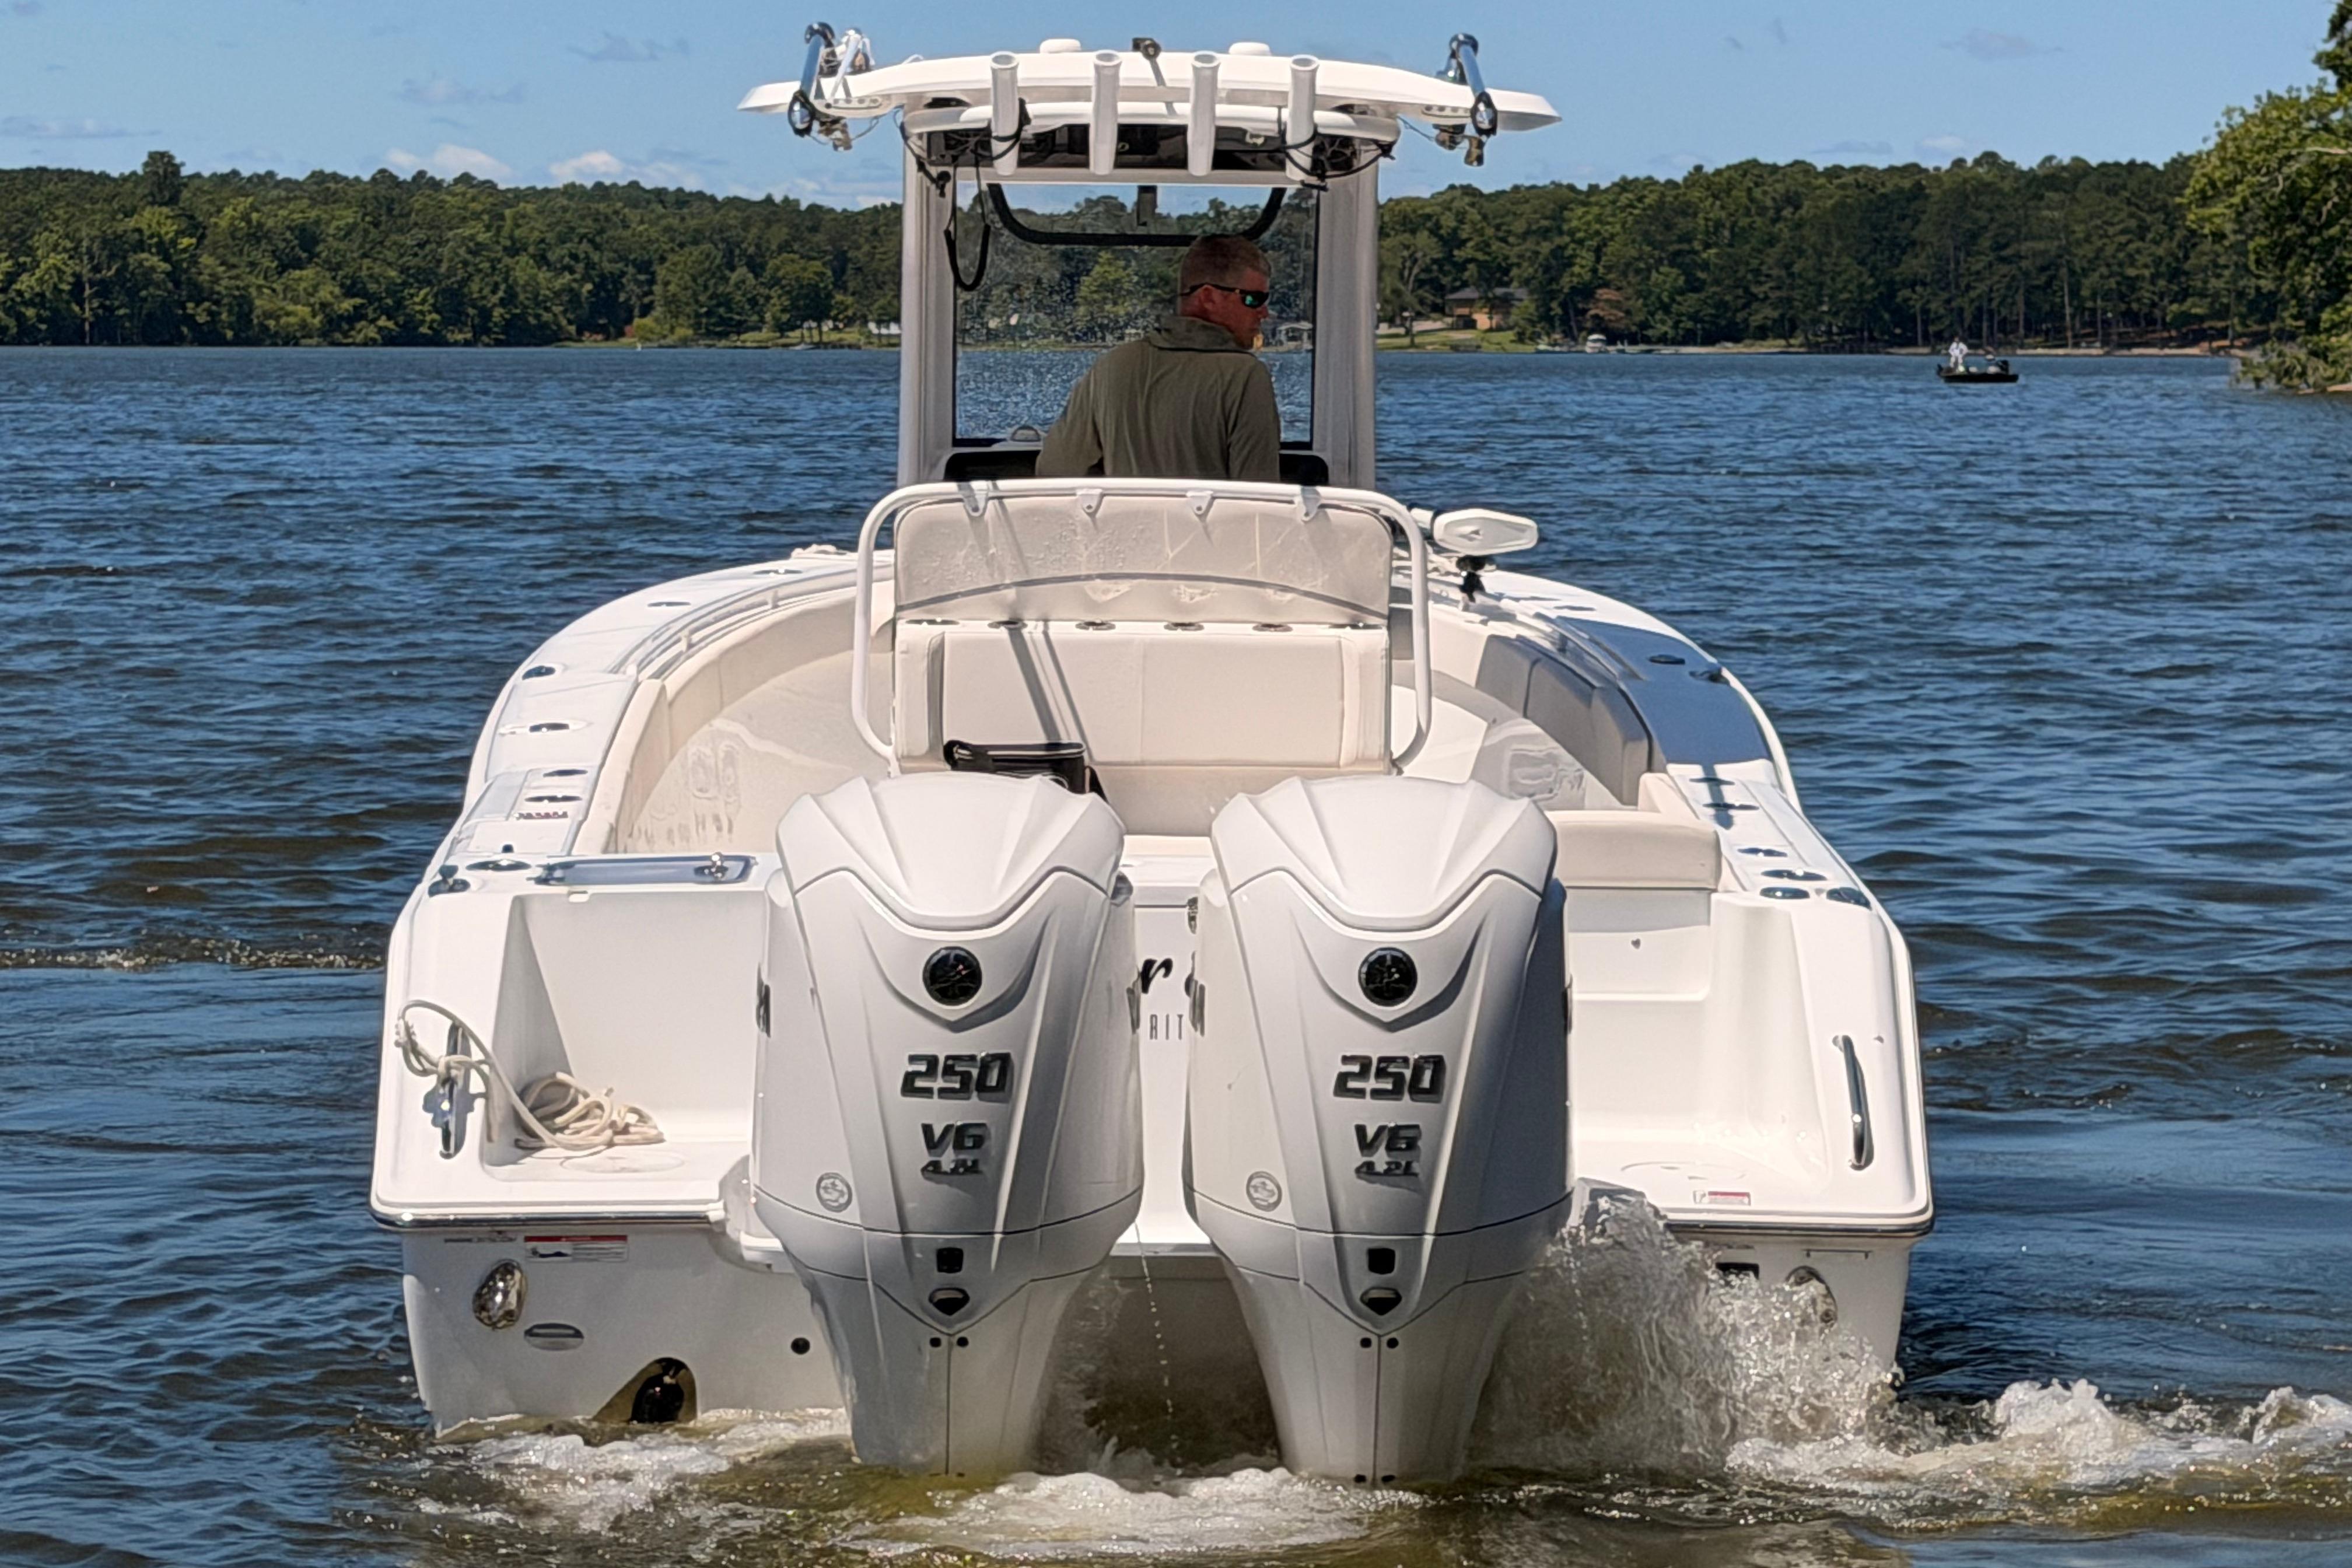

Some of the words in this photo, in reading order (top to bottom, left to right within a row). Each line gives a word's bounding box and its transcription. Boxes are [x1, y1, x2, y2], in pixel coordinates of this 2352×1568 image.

[901, 1052, 1013, 1102] 250
[1333, 1054, 1446, 1103] 250
[921, 1122, 988, 1157] V6
[1354, 1124, 1421, 1158] V6
